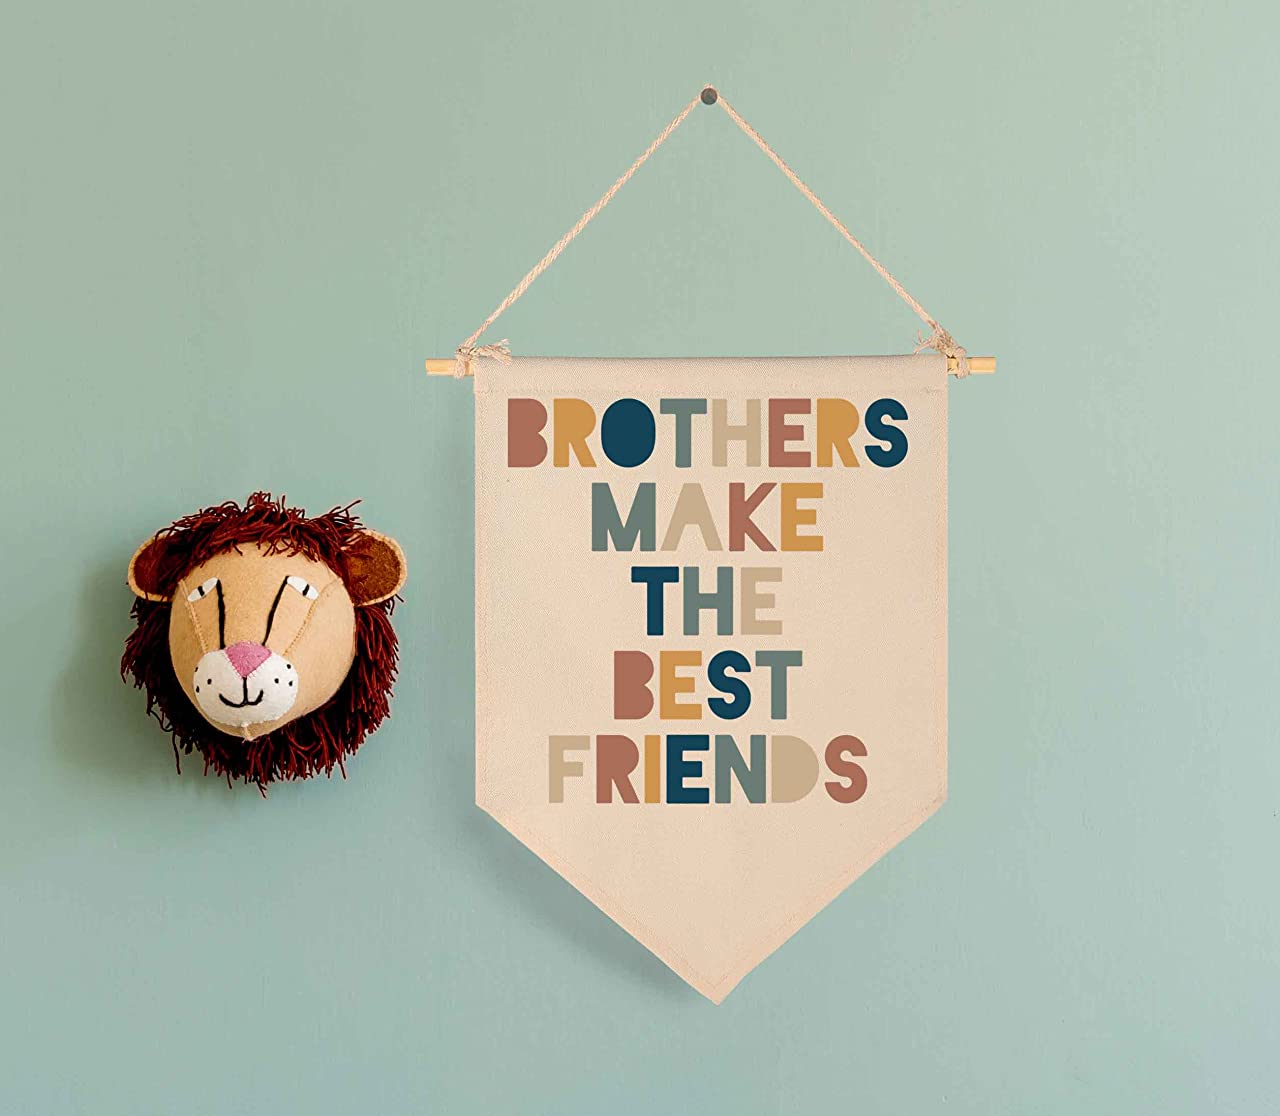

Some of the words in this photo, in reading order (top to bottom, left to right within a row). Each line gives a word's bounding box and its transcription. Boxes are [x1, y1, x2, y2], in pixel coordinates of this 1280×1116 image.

[507, 398, 909, 468] BROTHERS
[591, 482, 824, 552] MAKE
[631, 566, 783, 636] THE
[613, 649, 803, 720] BEST
[548, 734, 868, 805] FRIENDS
